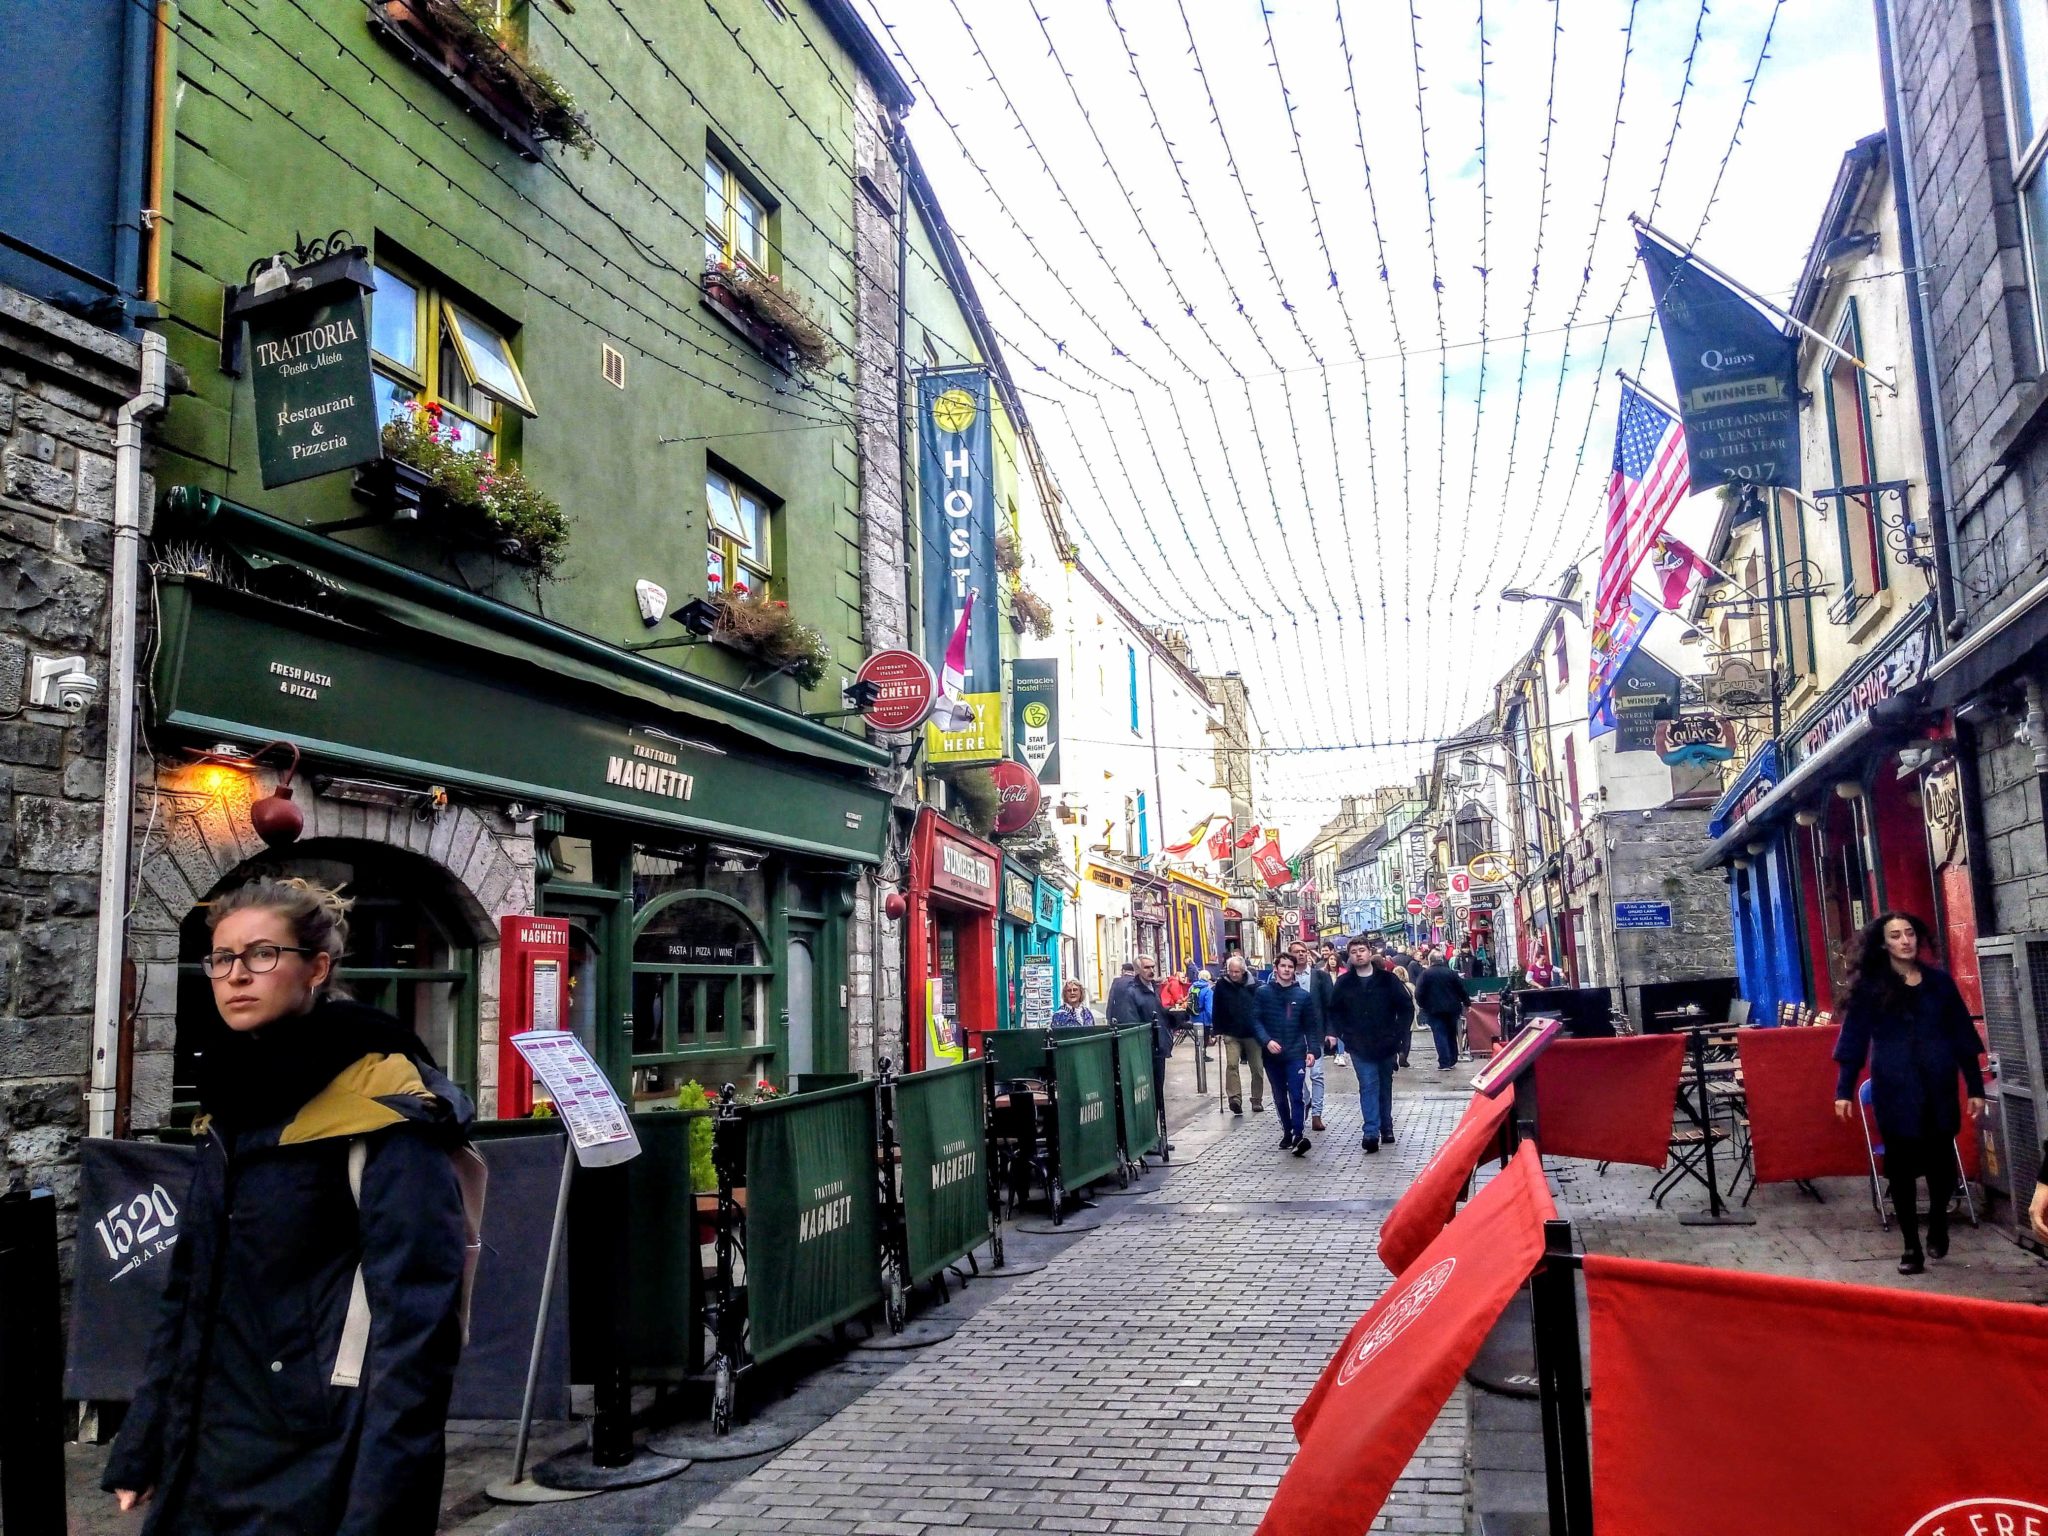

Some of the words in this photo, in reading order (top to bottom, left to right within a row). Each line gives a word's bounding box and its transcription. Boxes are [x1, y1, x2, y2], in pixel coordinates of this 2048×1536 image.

[257, 318, 359, 367] TRATTORIA
[279, 361, 309, 378] Pasta
[311, 352, 343, 370] Mista
[1701, 349, 1755, 371] Quays
[1702, 383, 1768, 403] WINNER
[277, 394, 356, 427] Restaurant
[311, 421, 325, 437] &
[1718, 426, 1766, 442] VENUE
[291, 434, 348, 460] Pizzeria
[1699, 447, 1718, 460] OF
[1719, 443, 1748, 457] THE
[1750, 438, 1786, 453] YEAR
[1723, 462, 1776, 481] 2017
[270, 661, 301, 680] FRESH
[303, 670, 332, 687] PASTA
[1016, 677, 1054, 685] barnacles
[1627, 677, 1656, 690] Quays
[280, 681, 288, 693] &
[290, 684, 318, 700] PIZZA
[877, 685, 921, 699] GNETTI
[1016, 684, 1039, 692] hostel
[1719, 680, 1757, 693] PUB
[1684, 721, 1704, 731] THE
[943, 737, 985, 752] HERE
[1636, 737, 1656, 746] 201
[1673, 727, 1717, 745] QUAYS
[633, 744, 677, 766] TRATTORIA
[1028, 752, 1046, 760] HERE
[605, 755, 694, 801] MAGNETTI
[943, 845, 977, 885] NUMBER
[976, 860, 990, 890] TEN
[1411, 835, 1426, 883] SWEATERS
[521, 929, 566, 945] MAGNETTI
[668, 945, 687, 955] PASTA
[695, 946, 711, 956] PIZZA
[718, 947, 733, 957] WINE
[942, 1138, 966, 1156] TRATTORIA
[931, 1151, 976, 1190] MAGNETTI
[814, 1180, 843, 1201] TRATTORIA
[94, 1183, 179, 1261] 1520
[131, 1240, 168, 1269] BAR
